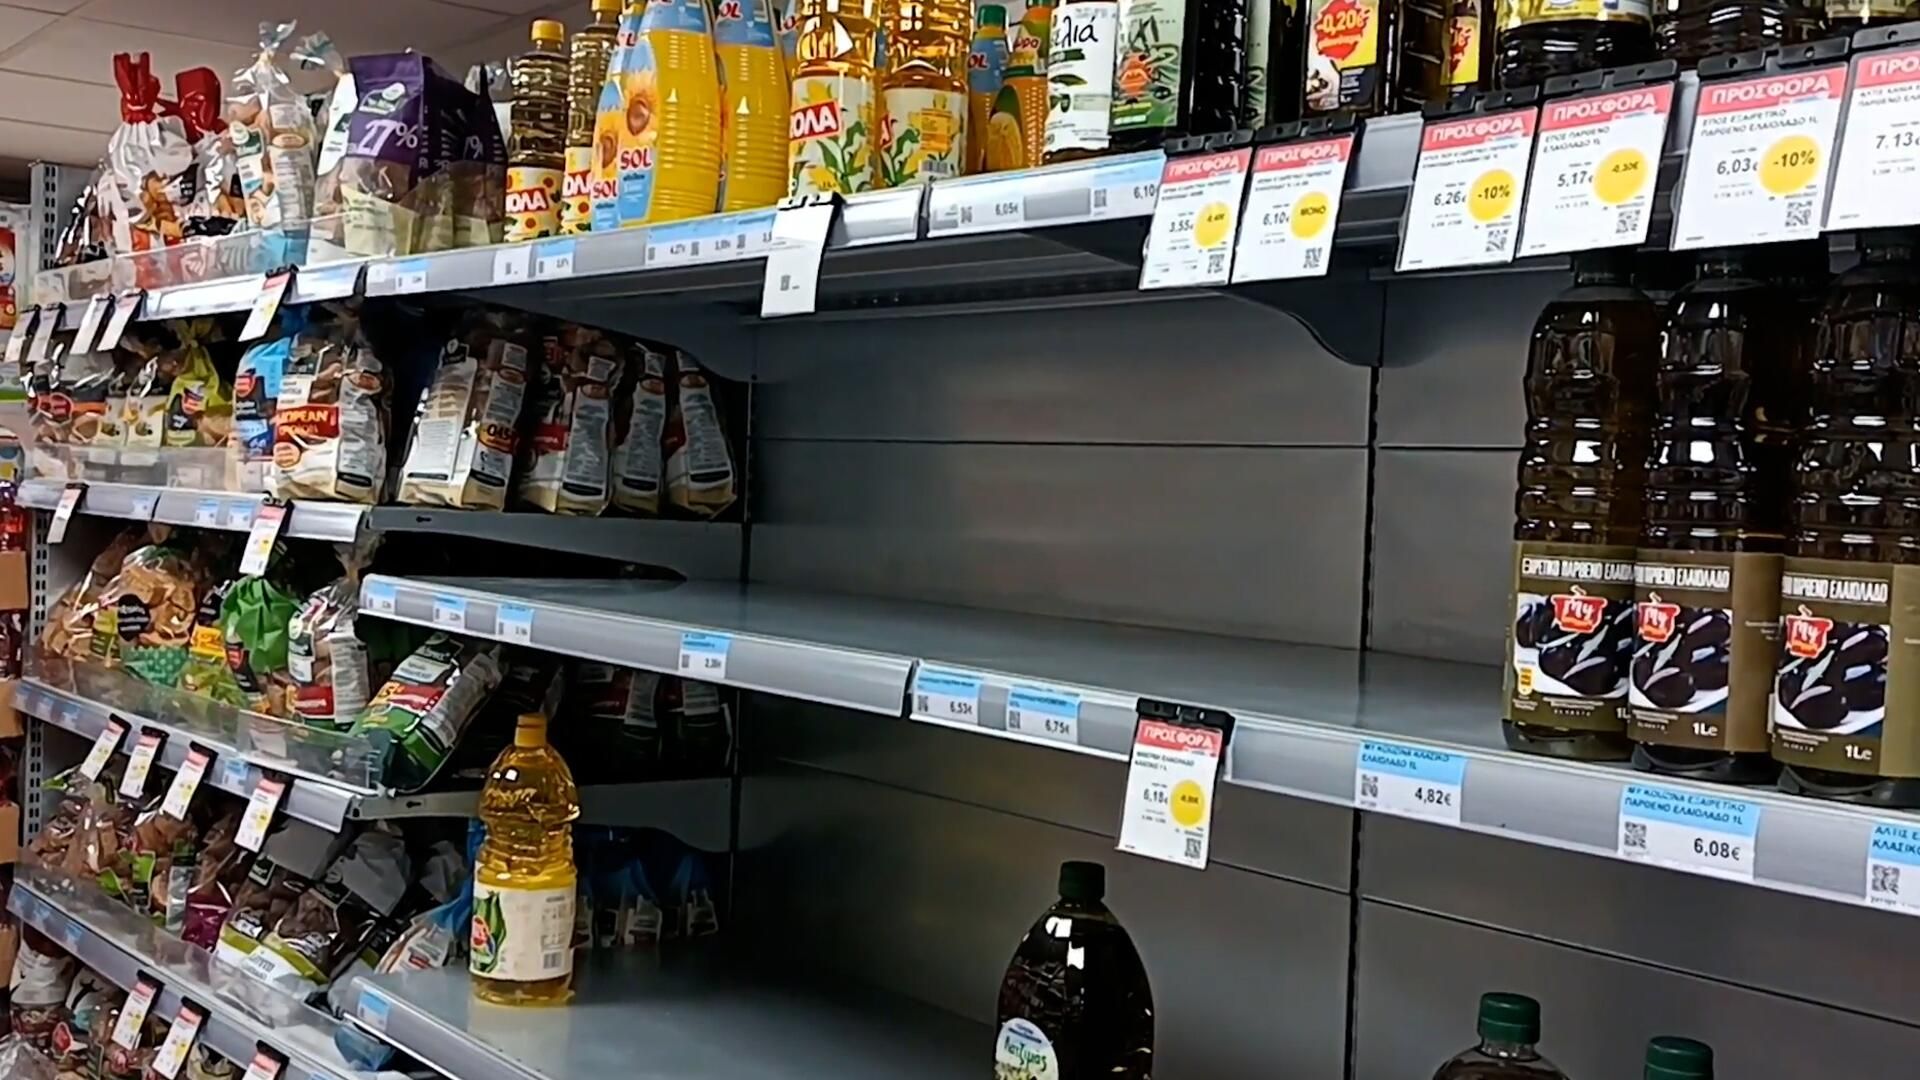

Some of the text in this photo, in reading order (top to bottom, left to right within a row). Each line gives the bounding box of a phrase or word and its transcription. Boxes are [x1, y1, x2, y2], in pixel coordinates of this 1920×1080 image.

[1711, 75, 1829, 105] ΠΡΟΣΦΟΡΑ
[1553, 93, 1656, 122] ΠΡΟΣΦΟΡΑ
[1432, 117, 1524, 142] ΠΡΟΣΦΟΡΑ
[620, 148, 652, 170] SOL
[1264, 144, 1340, 164] ΠΡΟΣΦΟΡΑ
[1773, 150, 1815, 168] -10%
[1169, 154, 1240, 177] ΠΡΟΣΦΟΡΑ
[593, 181, 618, 199] SOL
[1477, 184, 1511, 200] -10%
[1676, 568, 1730, 588] ΕΛΑΙΟΛΑΔΟ
[1829, 580, 1888, 603] ΕΛΑΙΟΛΑΔΟ
[1565, 599, 1594, 619] My
[1645, 607, 1670, 629] My
[1794, 619, 1819, 642] My
[1143, 726, 1213, 749] ΠΡΟΣΦΟΡΑ
[1414, 787, 1452, 806] 4,82€
[1673, 805, 1730, 822] ΕΛΑΙΟΛΑΔΟ
[1693, 837, 1741, 861] 6,08€
